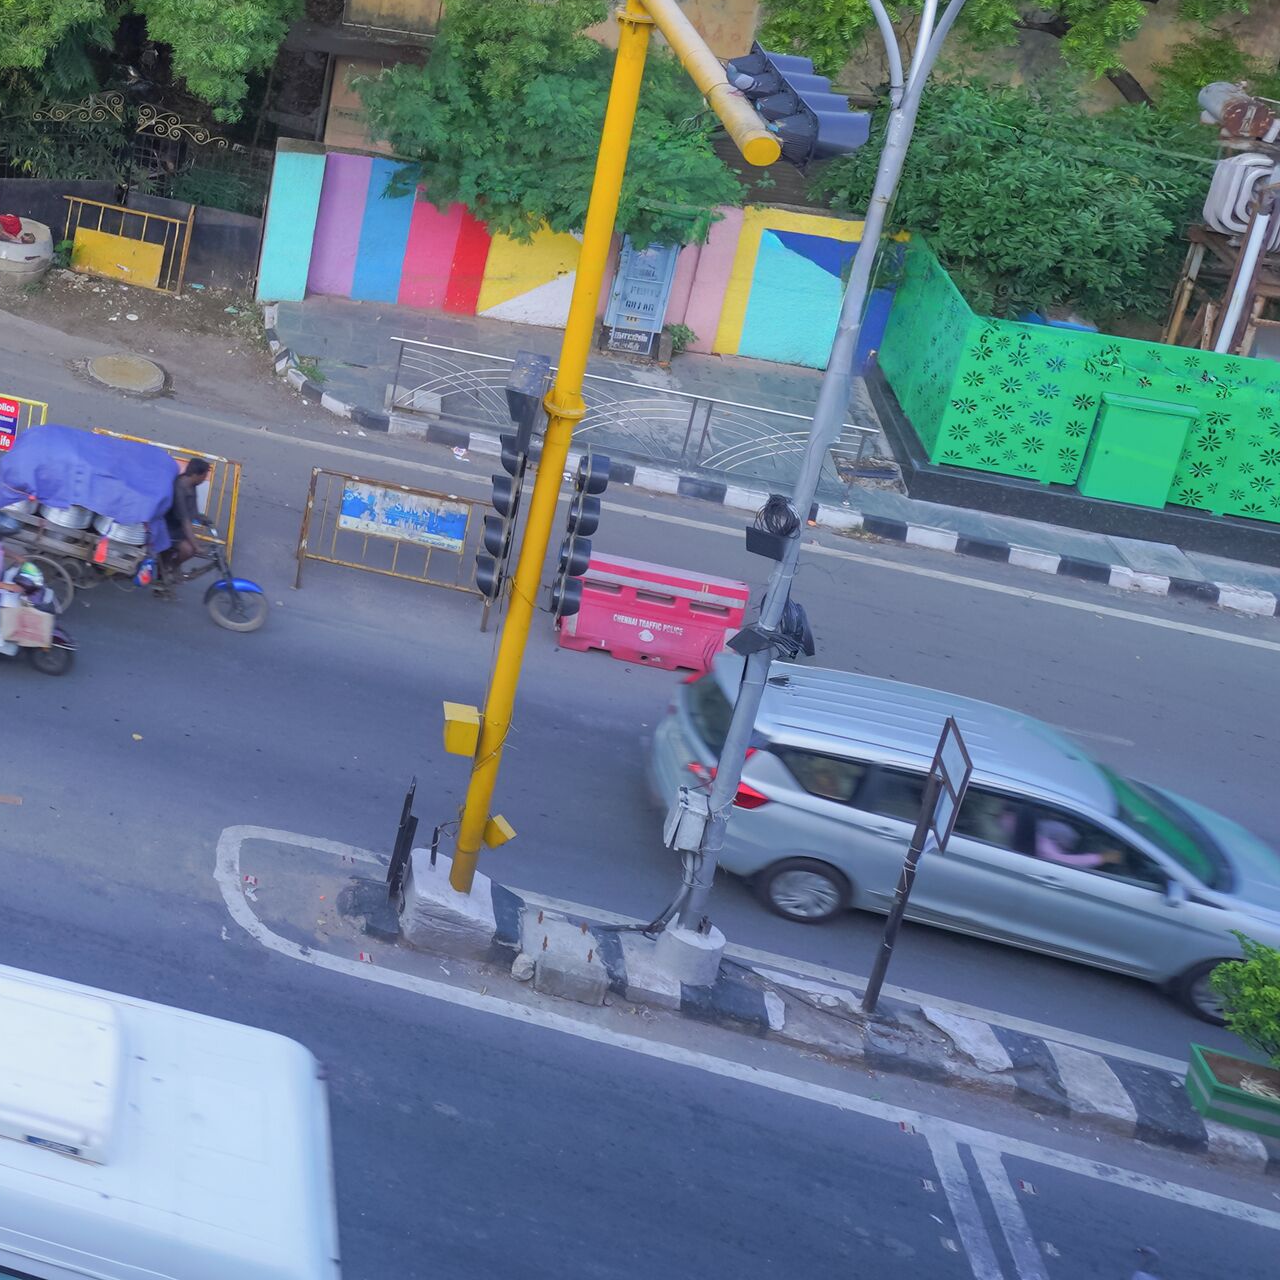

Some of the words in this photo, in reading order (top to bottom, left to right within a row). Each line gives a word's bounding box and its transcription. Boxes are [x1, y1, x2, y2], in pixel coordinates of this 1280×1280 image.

[613, 613, 638, 626] CHENNAI
[638, 618, 662, 631] TRAFFIC
[662, 624, 684, 636] POLICE
